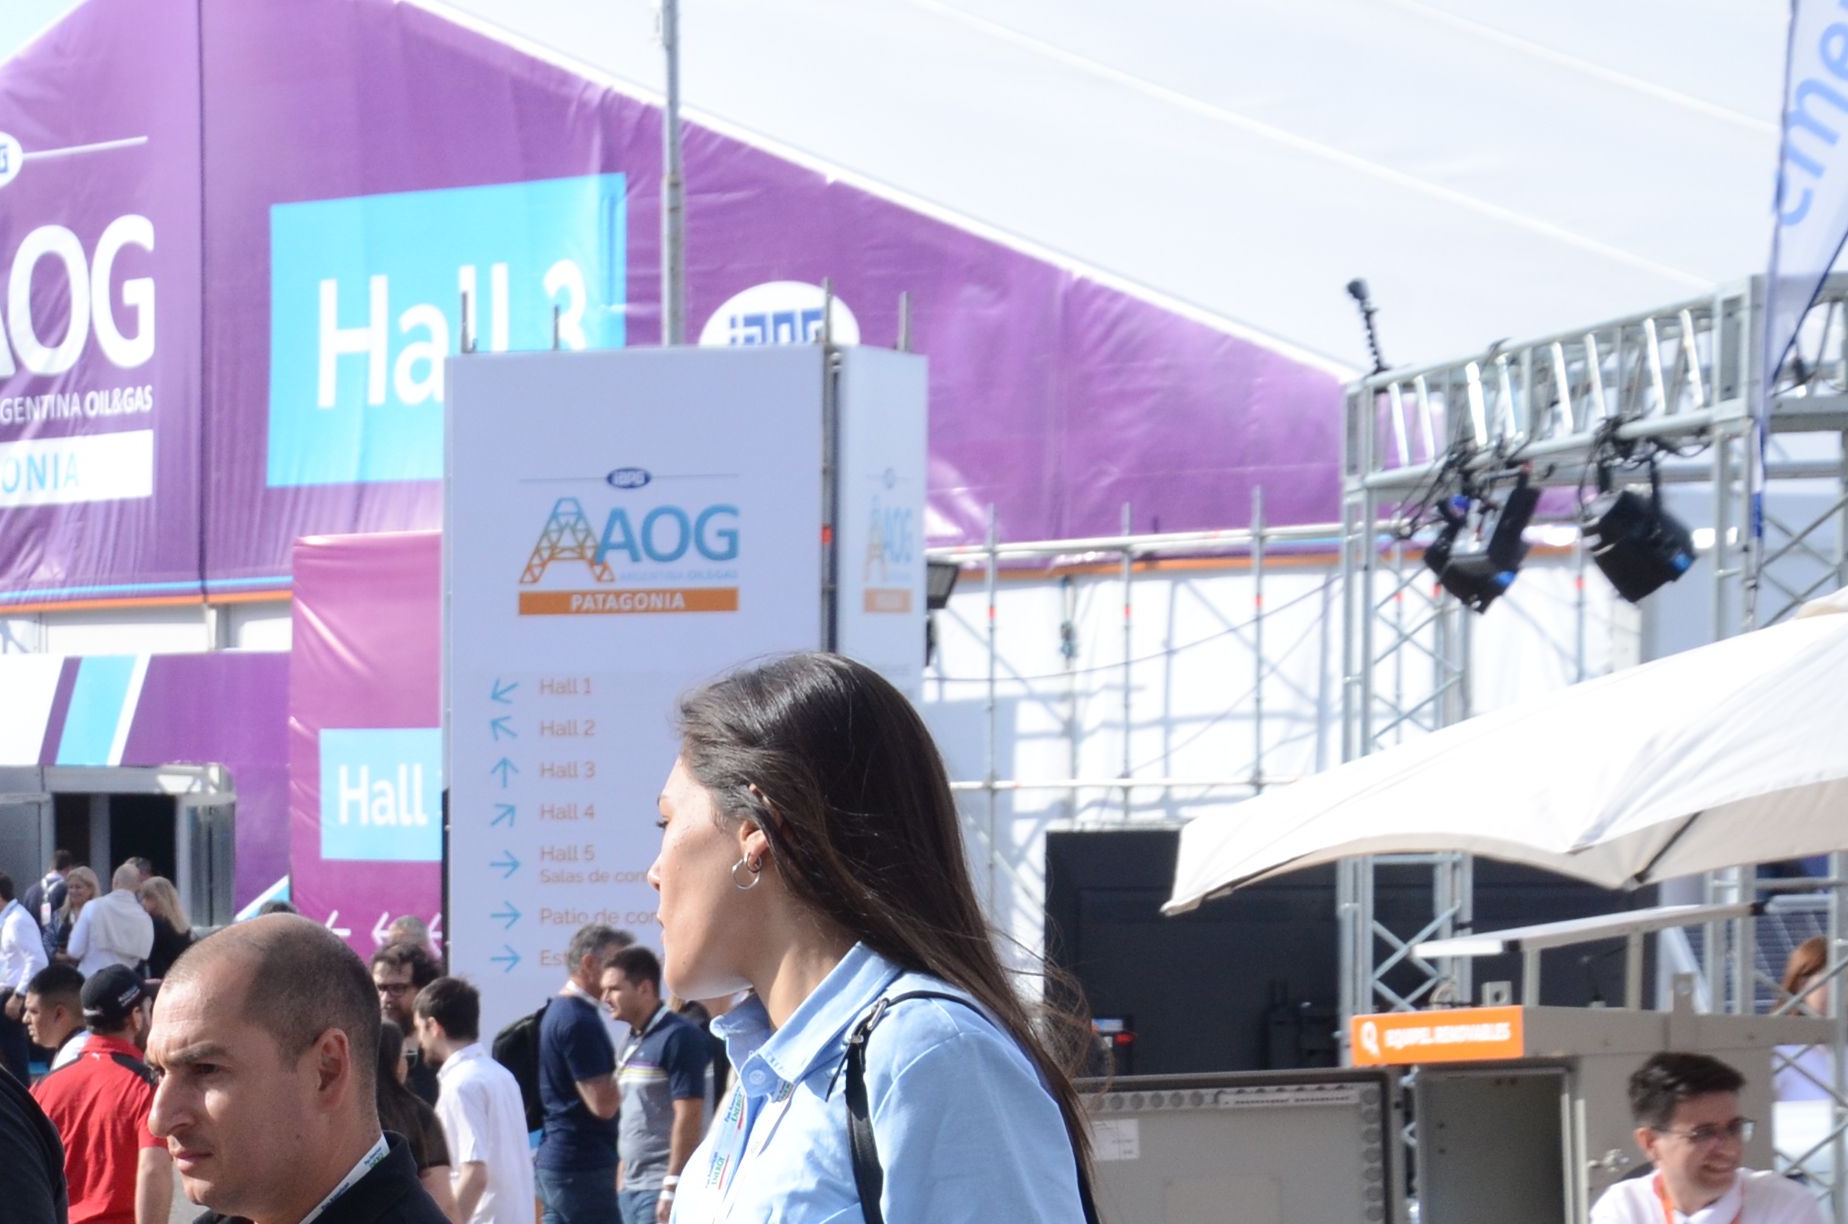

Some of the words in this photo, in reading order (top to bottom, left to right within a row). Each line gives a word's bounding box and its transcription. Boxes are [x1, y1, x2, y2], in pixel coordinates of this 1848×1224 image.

[317, 262, 510, 409] Hall
[84, 384, 153, 418] OIL&GAS
[570, 592, 686, 612] PATAGONIA
[540, 677, 579, 695] Hall
[582, 678, 592, 695] 1
[540, 719, 579, 737] Hall
[583, 720, 596, 736] 2
[540, 761, 579, 779] Hall
[583, 762, 596, 778] 3
[338, 763, 428, 827] Hall
[540, 803, 579, 821] Hall
[583, 803, 596, 820] 4
[540, 844, 579, 862] Hall
[583, 845, 596, 861] 5
[540, 868, 584, 884] Salas
[588, 868, 610, 883] de
[540, 907, 588, 925] Patio
[594, 907, 619, 924] de
